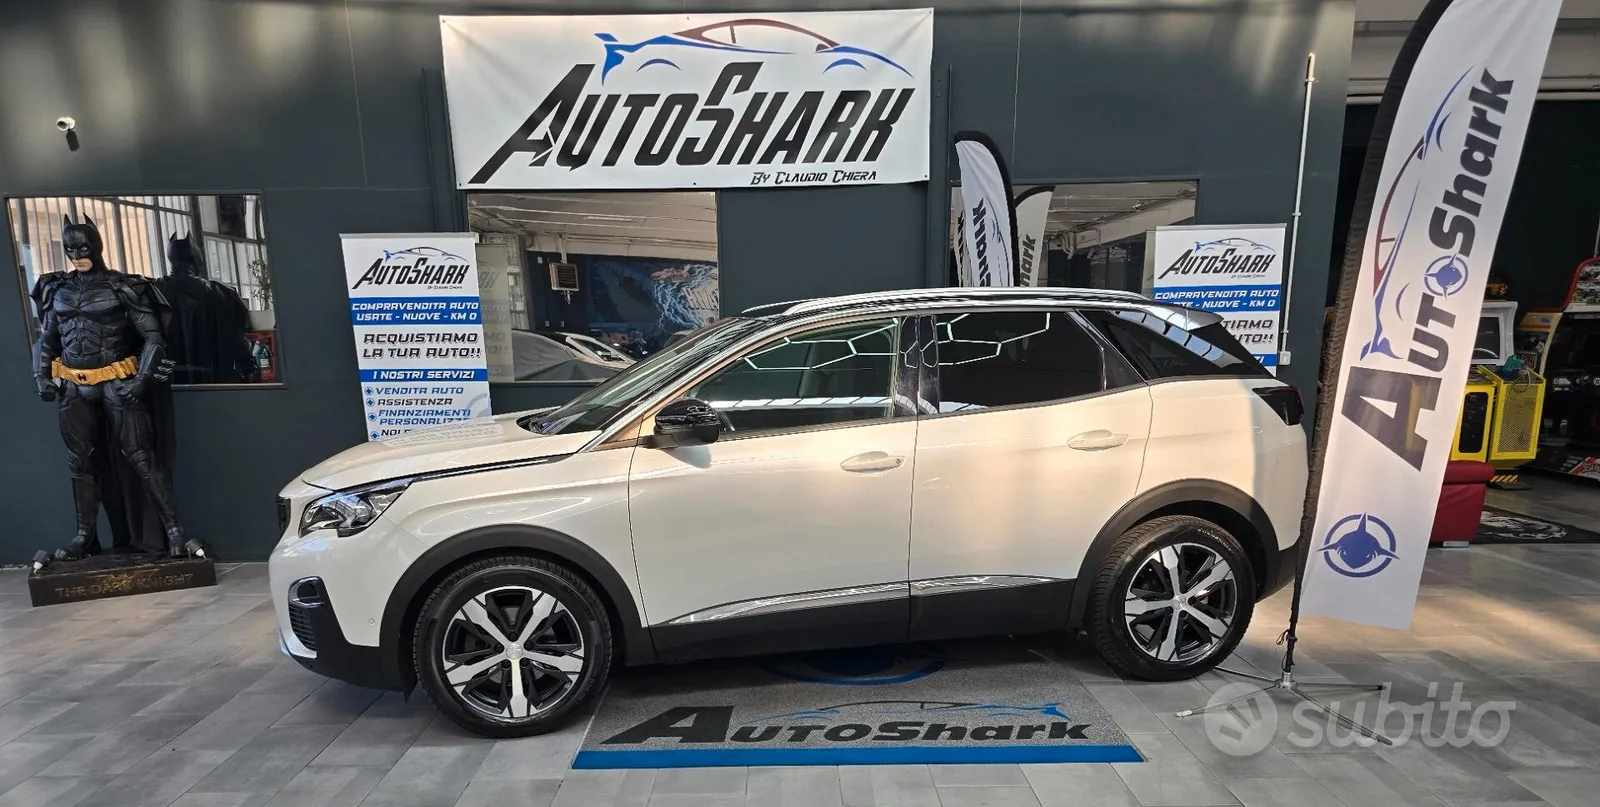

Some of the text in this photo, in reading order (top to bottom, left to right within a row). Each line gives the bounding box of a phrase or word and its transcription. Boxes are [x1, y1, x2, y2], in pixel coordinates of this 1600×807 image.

[774, 171, 828, 185] CLAUDIO
[831, 170, 877, 183] CHIERA
[1154, 289, 1279, 299] COMPRAVENDITA AUTO
[352, 302, 479, 311] COMPRAVENDITA AUTO
[1202, 300, 1240, 308] NUOVE
[356, 313, 393, 321] USATE
[402, 312, 441, 320] NUOVE
[450, 312, 467, 320] KM
[1222, 320, 1273, 329] TIAMO
[363, 332, 478, 345] ACQUISTIAMO
[363, 347, 481, 358] LA TUA AUTO!!
[373, 370, 475, 379] I NOSTRI SERVIZI
[375, 387, 427, 395] VENDITA
[377, 398, 453, 406] ASSISTENZA
[55, 585, 87, 597] THE
[137, 573, 194, 589] KNIGHT
